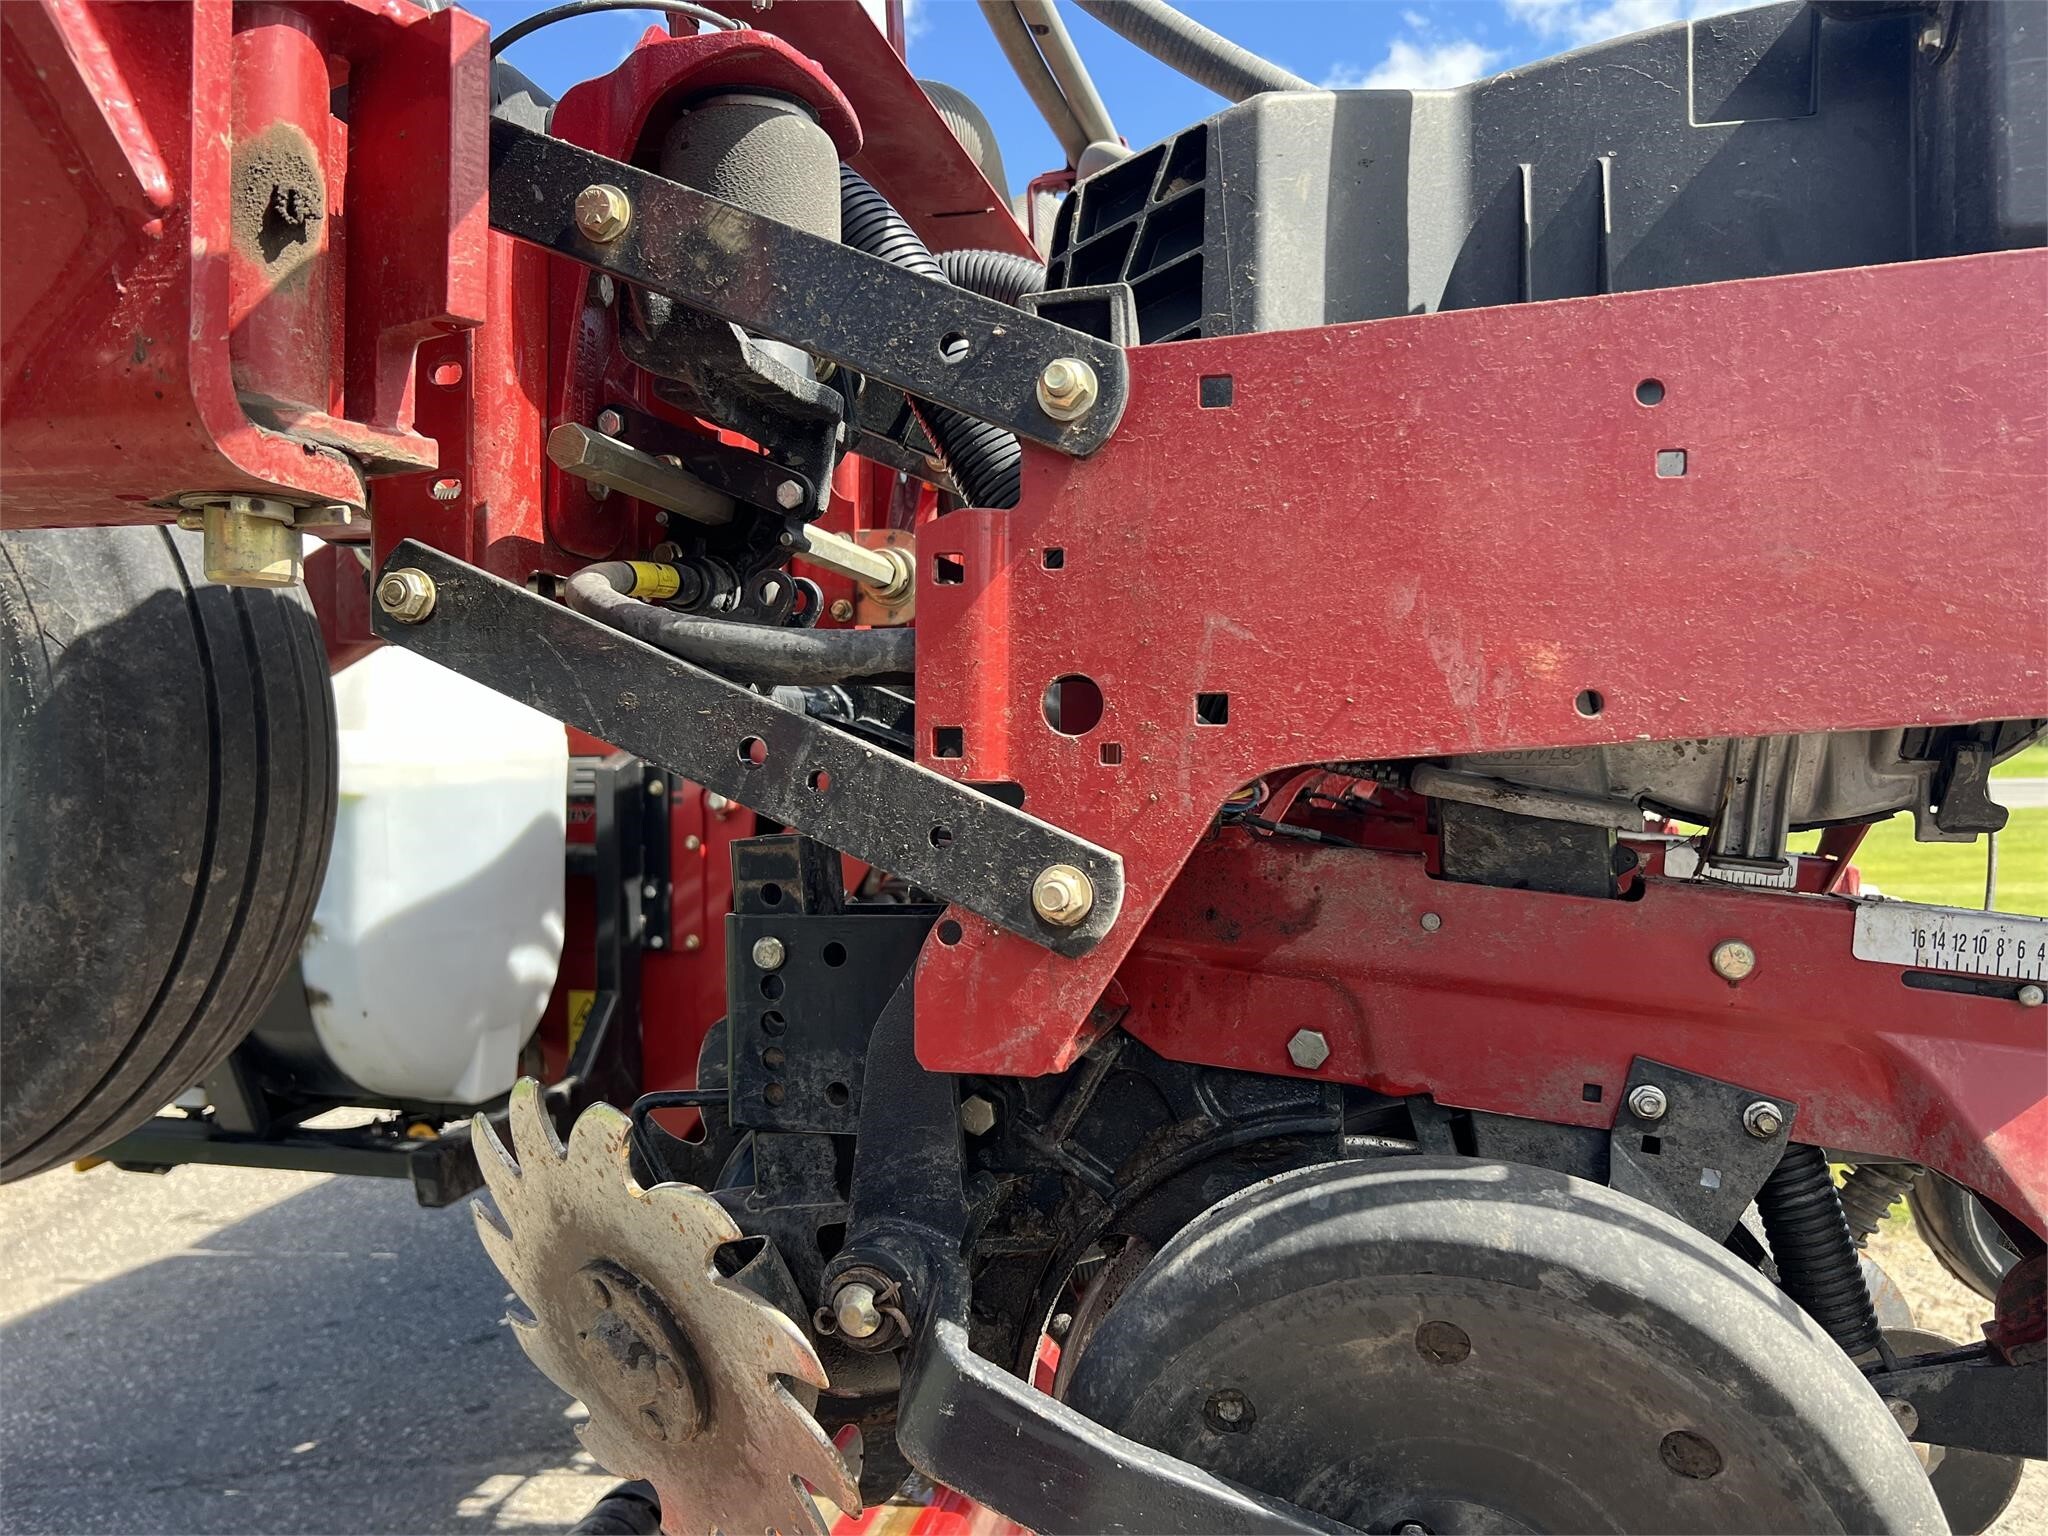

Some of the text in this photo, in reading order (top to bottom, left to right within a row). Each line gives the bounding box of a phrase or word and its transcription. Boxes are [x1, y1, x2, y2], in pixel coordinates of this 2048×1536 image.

[1912, 929, 2046, 961] 16 14 12 10 8 6 4
